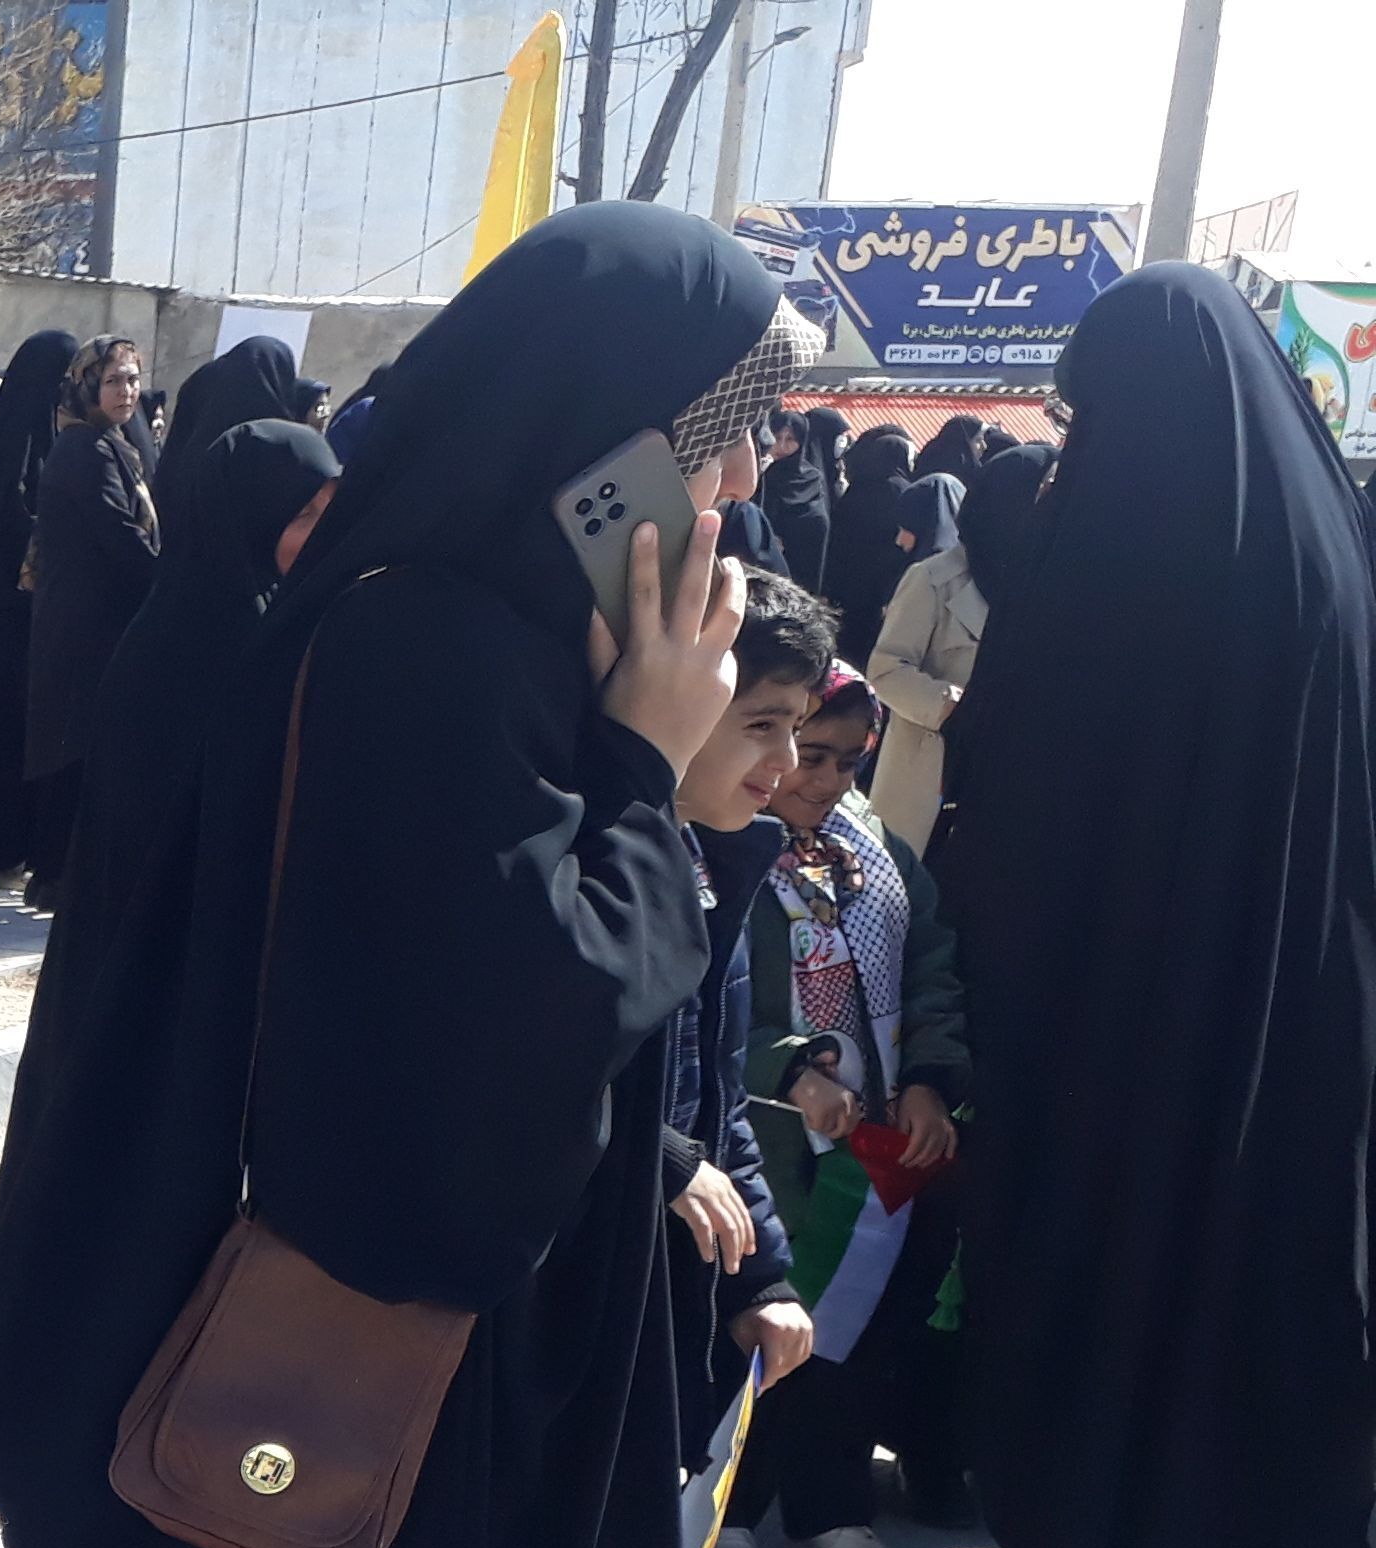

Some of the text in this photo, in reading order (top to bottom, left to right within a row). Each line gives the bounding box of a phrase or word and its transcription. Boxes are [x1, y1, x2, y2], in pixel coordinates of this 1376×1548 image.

[836, 210, 1087, 273] باطری فروشی
[917, 277, 1039, 316] عابد
